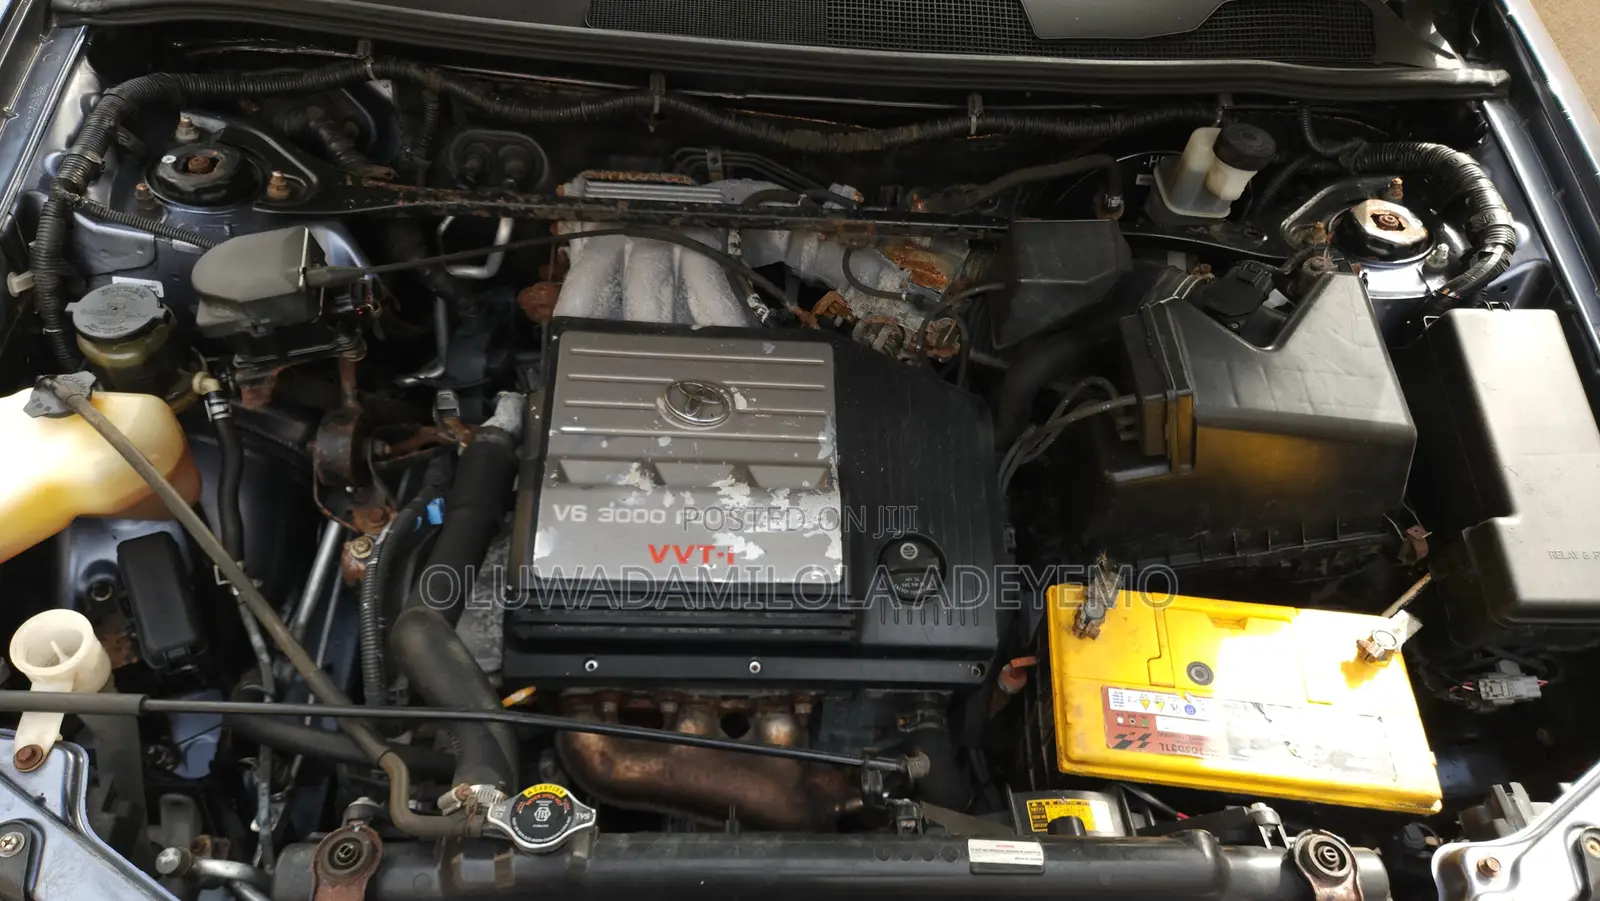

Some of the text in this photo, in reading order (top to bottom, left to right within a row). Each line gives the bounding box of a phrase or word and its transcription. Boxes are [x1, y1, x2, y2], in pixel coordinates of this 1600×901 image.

[552, 503, 588, 522] V6
[597, 506, 666, 524] 3000
[533, 784, 564, 795] CAUTION
[575, 812, 591, 820] TVS
